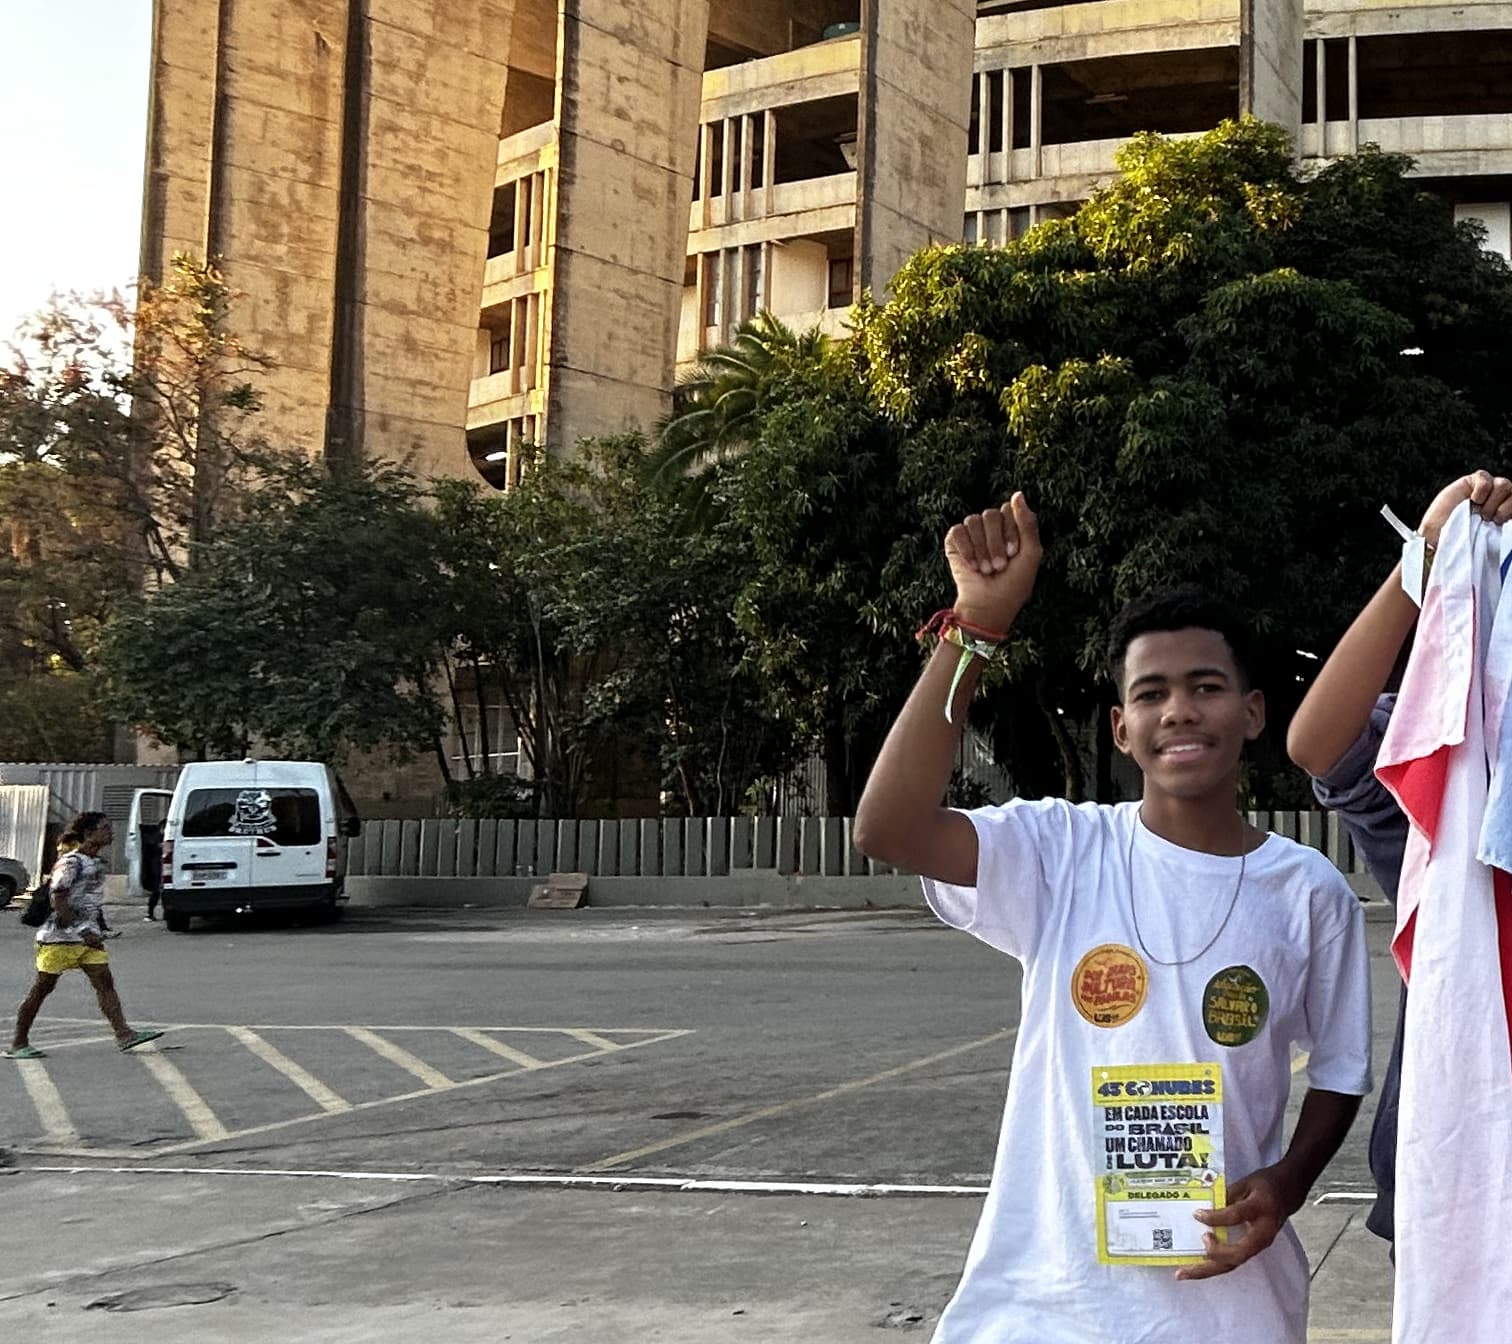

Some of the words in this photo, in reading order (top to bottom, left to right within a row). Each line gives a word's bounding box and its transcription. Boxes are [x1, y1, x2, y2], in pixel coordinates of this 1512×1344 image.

[1105, 1106, 1123, 1121] EM
[1125, 1106, 1159, 1121] CADA
[1160, 1105, 1209, 1120] ESCOLA
[1105, 1124, 1125, 1132] DO
[1128, 1122, 1209, 1135] BRASIL
[1105, 1137, 1126, 1153] UM
[1127, 1136, 1193, 1152] CHAMADO
[1127, 1191, 1180, 1200] DELEGADO
